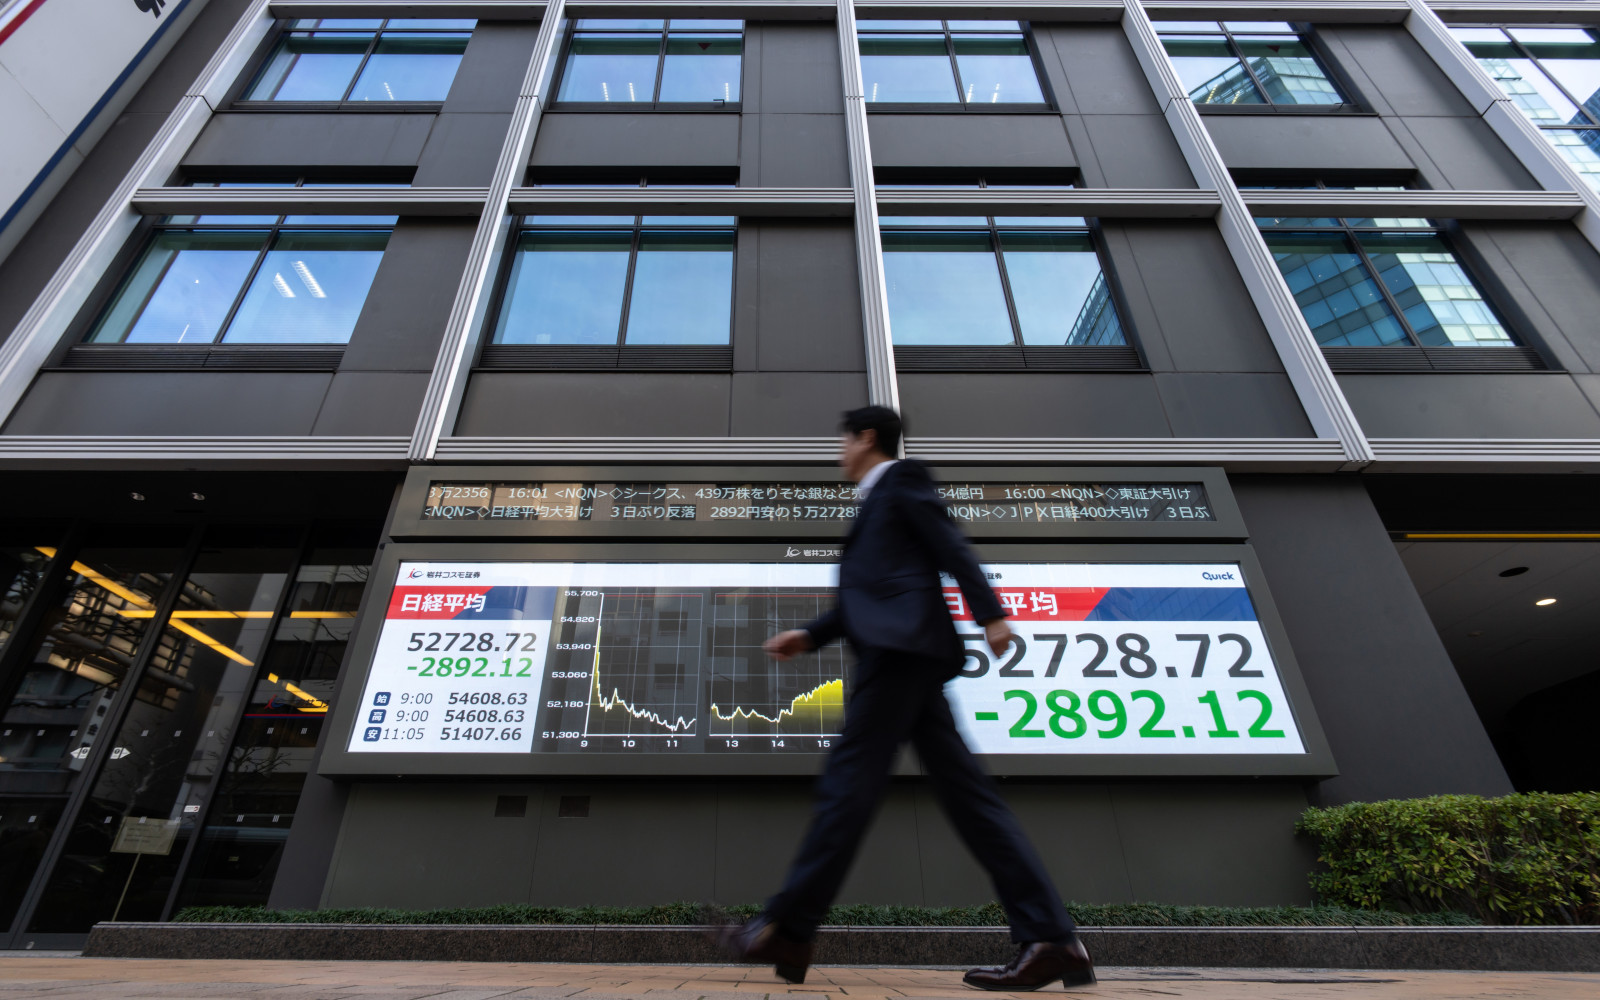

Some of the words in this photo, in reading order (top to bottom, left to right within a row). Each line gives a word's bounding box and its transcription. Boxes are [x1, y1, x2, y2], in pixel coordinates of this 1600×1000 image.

[508, 487, 549, 499] 16:01
[935, 487, 984, 500] 54億円
[1004, 487, 1046, 500] 16:00
[610, 505, 696, 519] 3日ぶり反落
[946, 505, 1150, 520] NQN>◇JPX日経400大引け
[1166, 505, 1210, 519] 3日ぶ
[803, 549, 843, 557] 岩井コスモ
[426, 571, 481, 579] 岩井コスモ証券
[1202, 571, 1235, 582] Quick
[400, 593, 487, 613] 日経平均
[942, 591, 1059, 616] 日平均
[407, 632, 537, 652] 52728.72
[958, 632, 1265, 679] 52728.72
[407, 656, 533, 678] -2892.12
[400, 692, 433, 705] 9:00
[448, 692, 528, 705] 54608.63
[396, 710, 429, 722] 9:00
[444, 710, 525, 723] 54608.63
[975, 689, 1286, 739] -2892.12
[382, 728, 425, 740] 11:05
[440, 727, 522, 741] 51407.66
[542, 731, 579, 739] 51,300
[580, 740, 588, 748] 9
[622, 740, 636, 748] 10
[666, 740, 678, 748] 11
[725, 740, 739, 748] 13
[771, 740, 785, 748] 14
[817, 740, 831, 748] 15
